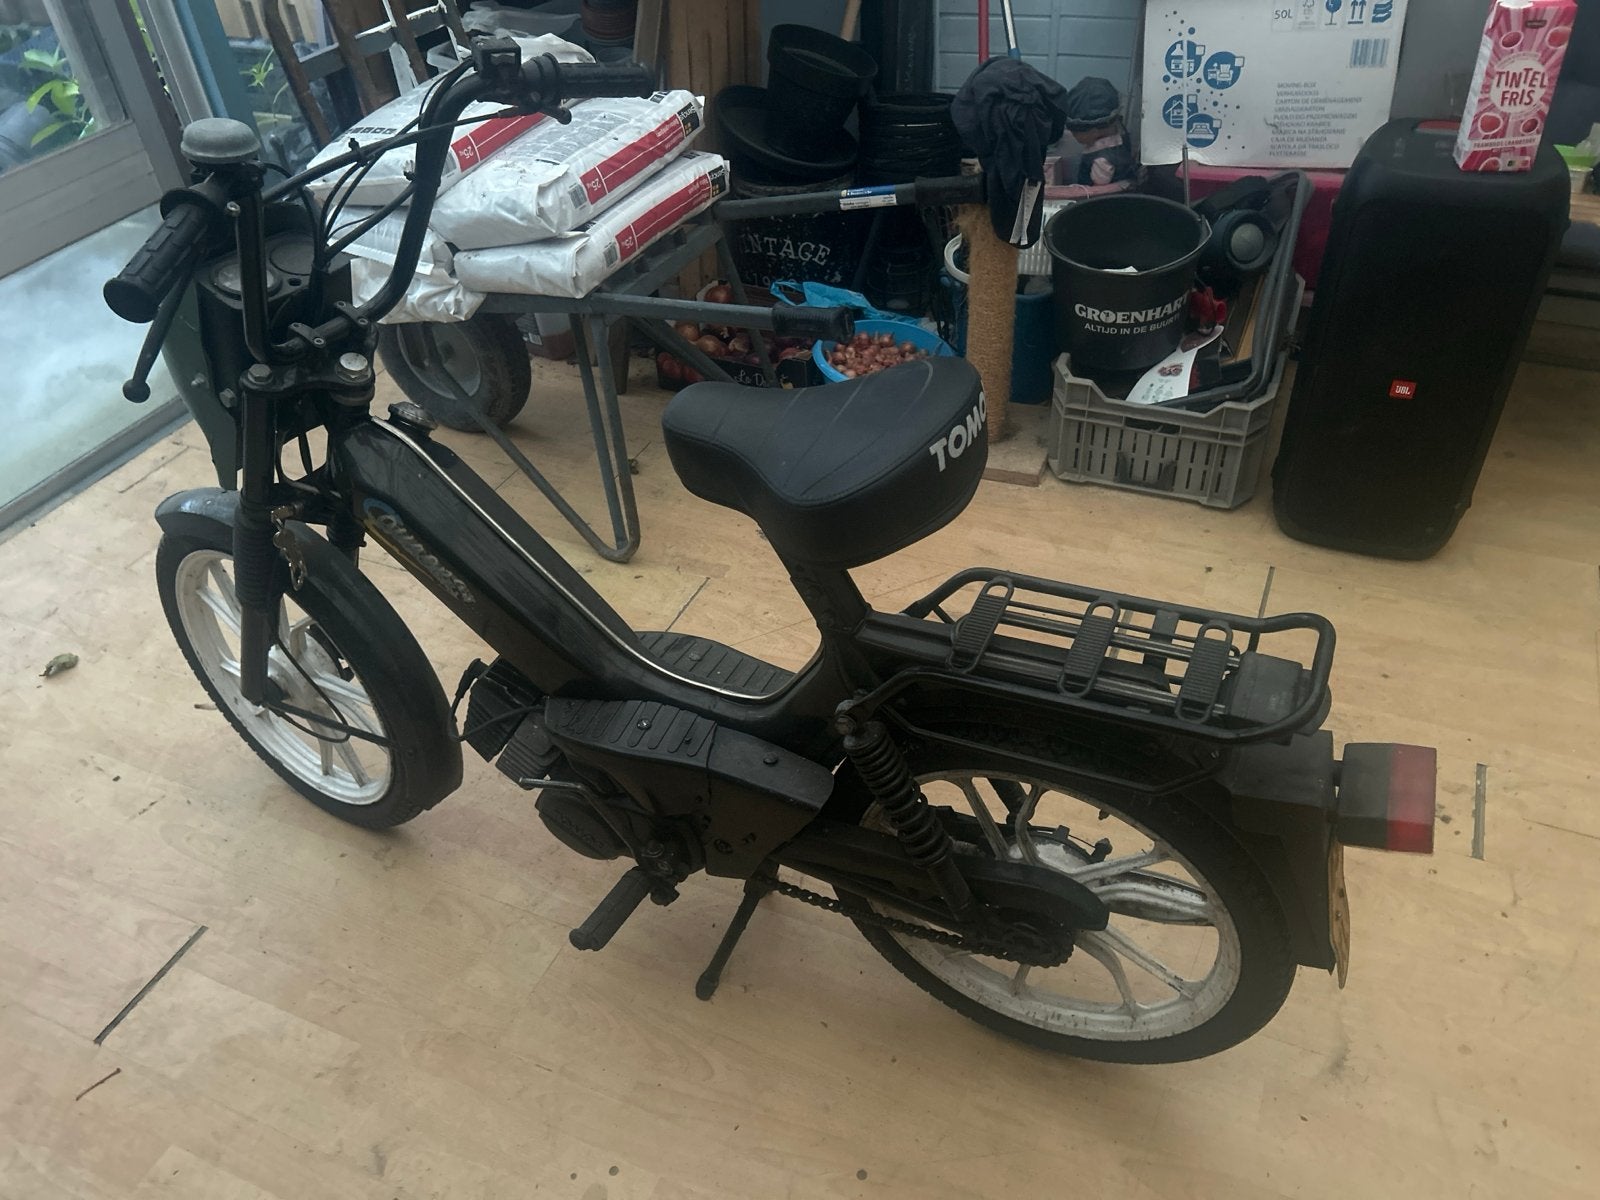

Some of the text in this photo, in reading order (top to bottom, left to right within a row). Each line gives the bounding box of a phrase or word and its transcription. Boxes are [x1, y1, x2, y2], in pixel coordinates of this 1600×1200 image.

[1273, 9, 1293, 20] 50L
[1495, 67, 1547, 88] TINTEL
[1500, 89, 1536, 107] FRIS
[1084, 322, 1118, 335] ALTIJD
[1120, 327, 1131, 335] IN
[1133, 325, 1148, 335] DE
[1395, 385, 1411, 395] JBL
[928, 388, 987, 473] TOMO
